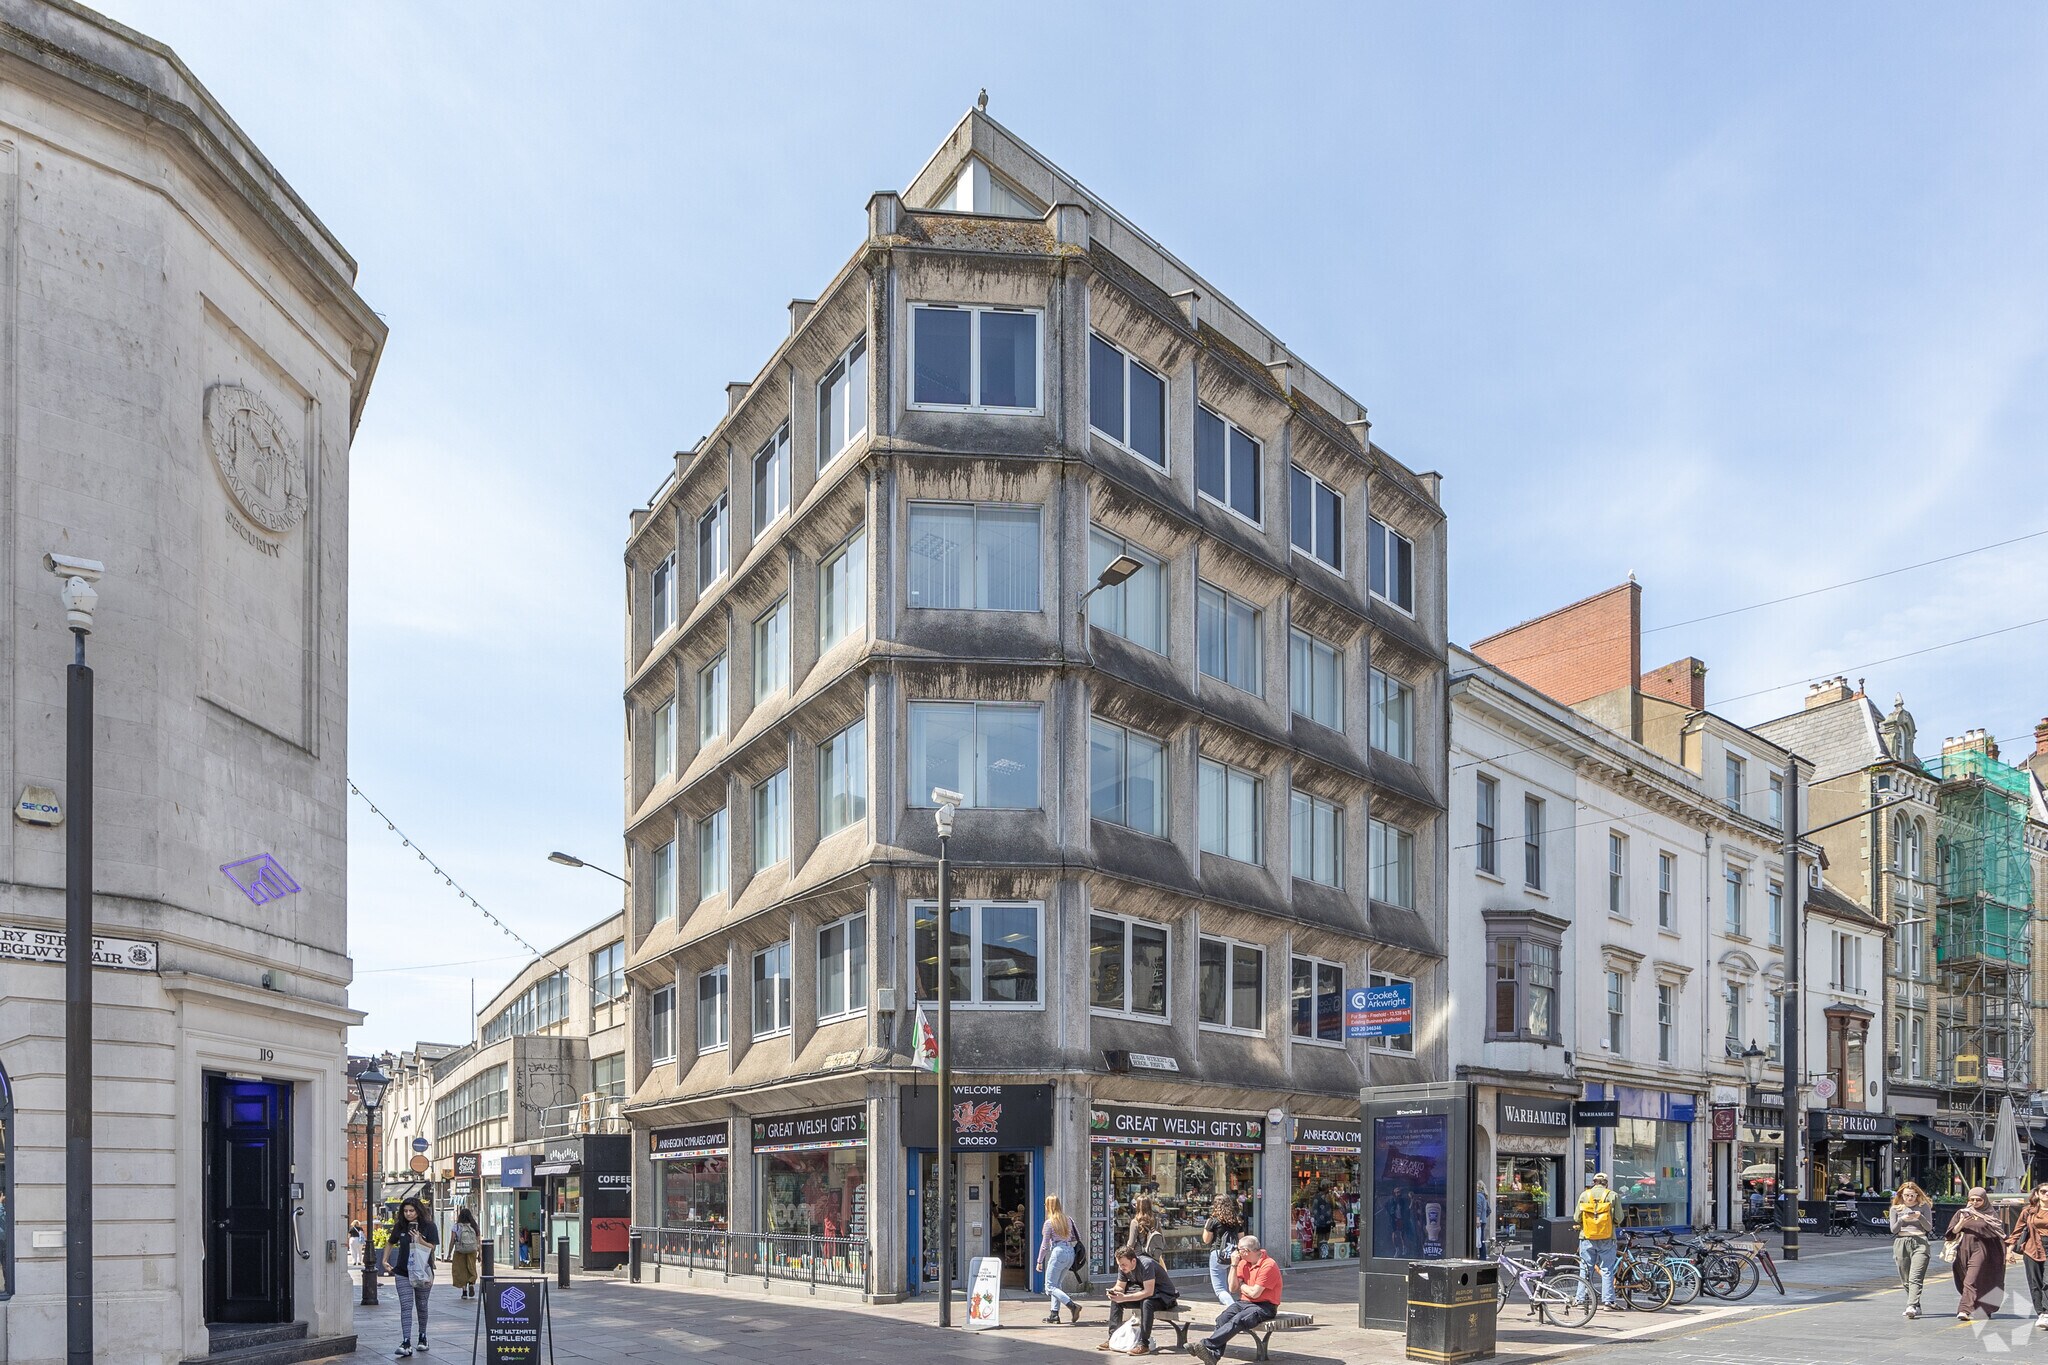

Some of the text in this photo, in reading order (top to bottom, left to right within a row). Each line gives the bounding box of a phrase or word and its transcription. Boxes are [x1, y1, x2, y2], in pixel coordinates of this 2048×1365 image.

[235, 389, 286, 438] TRUSTEE
[224, 465, 297, 531] SAVINGS BANK
[225, 510, 281, 559] SECURITY
[22, 802, 58, 813] SECOM
[35, 933, 104, 950] STRT
[0, 943, 66, 958] EGLWY
[1368, 998, 1406, 1008] Arkwright
[260, 1048, 274, 1061] 119
[953, 1086, 1001, 1094] WELCOME
[1951, 1102, 1973, 1110] CASTLE
[1505, 1105, 1567, 1126] WARHAMMER
[768, 1115, 857, 1138] GREAT WELSH GIFTS
[1116, 1114, 1242, 1136] GREAT WELSH GIFTS
[1843, 1117, 1877, 1131] PREGO
[707, 1133, 726, 1144] GWYCH
[958, 1136, 997, 1145] CROESO
[1303, 1129, 1344, 1141] ANRHEGION
[598, 1175, 631, 1183] COFFEE
[1423, 1247, 1443, 1255] HEINZ
